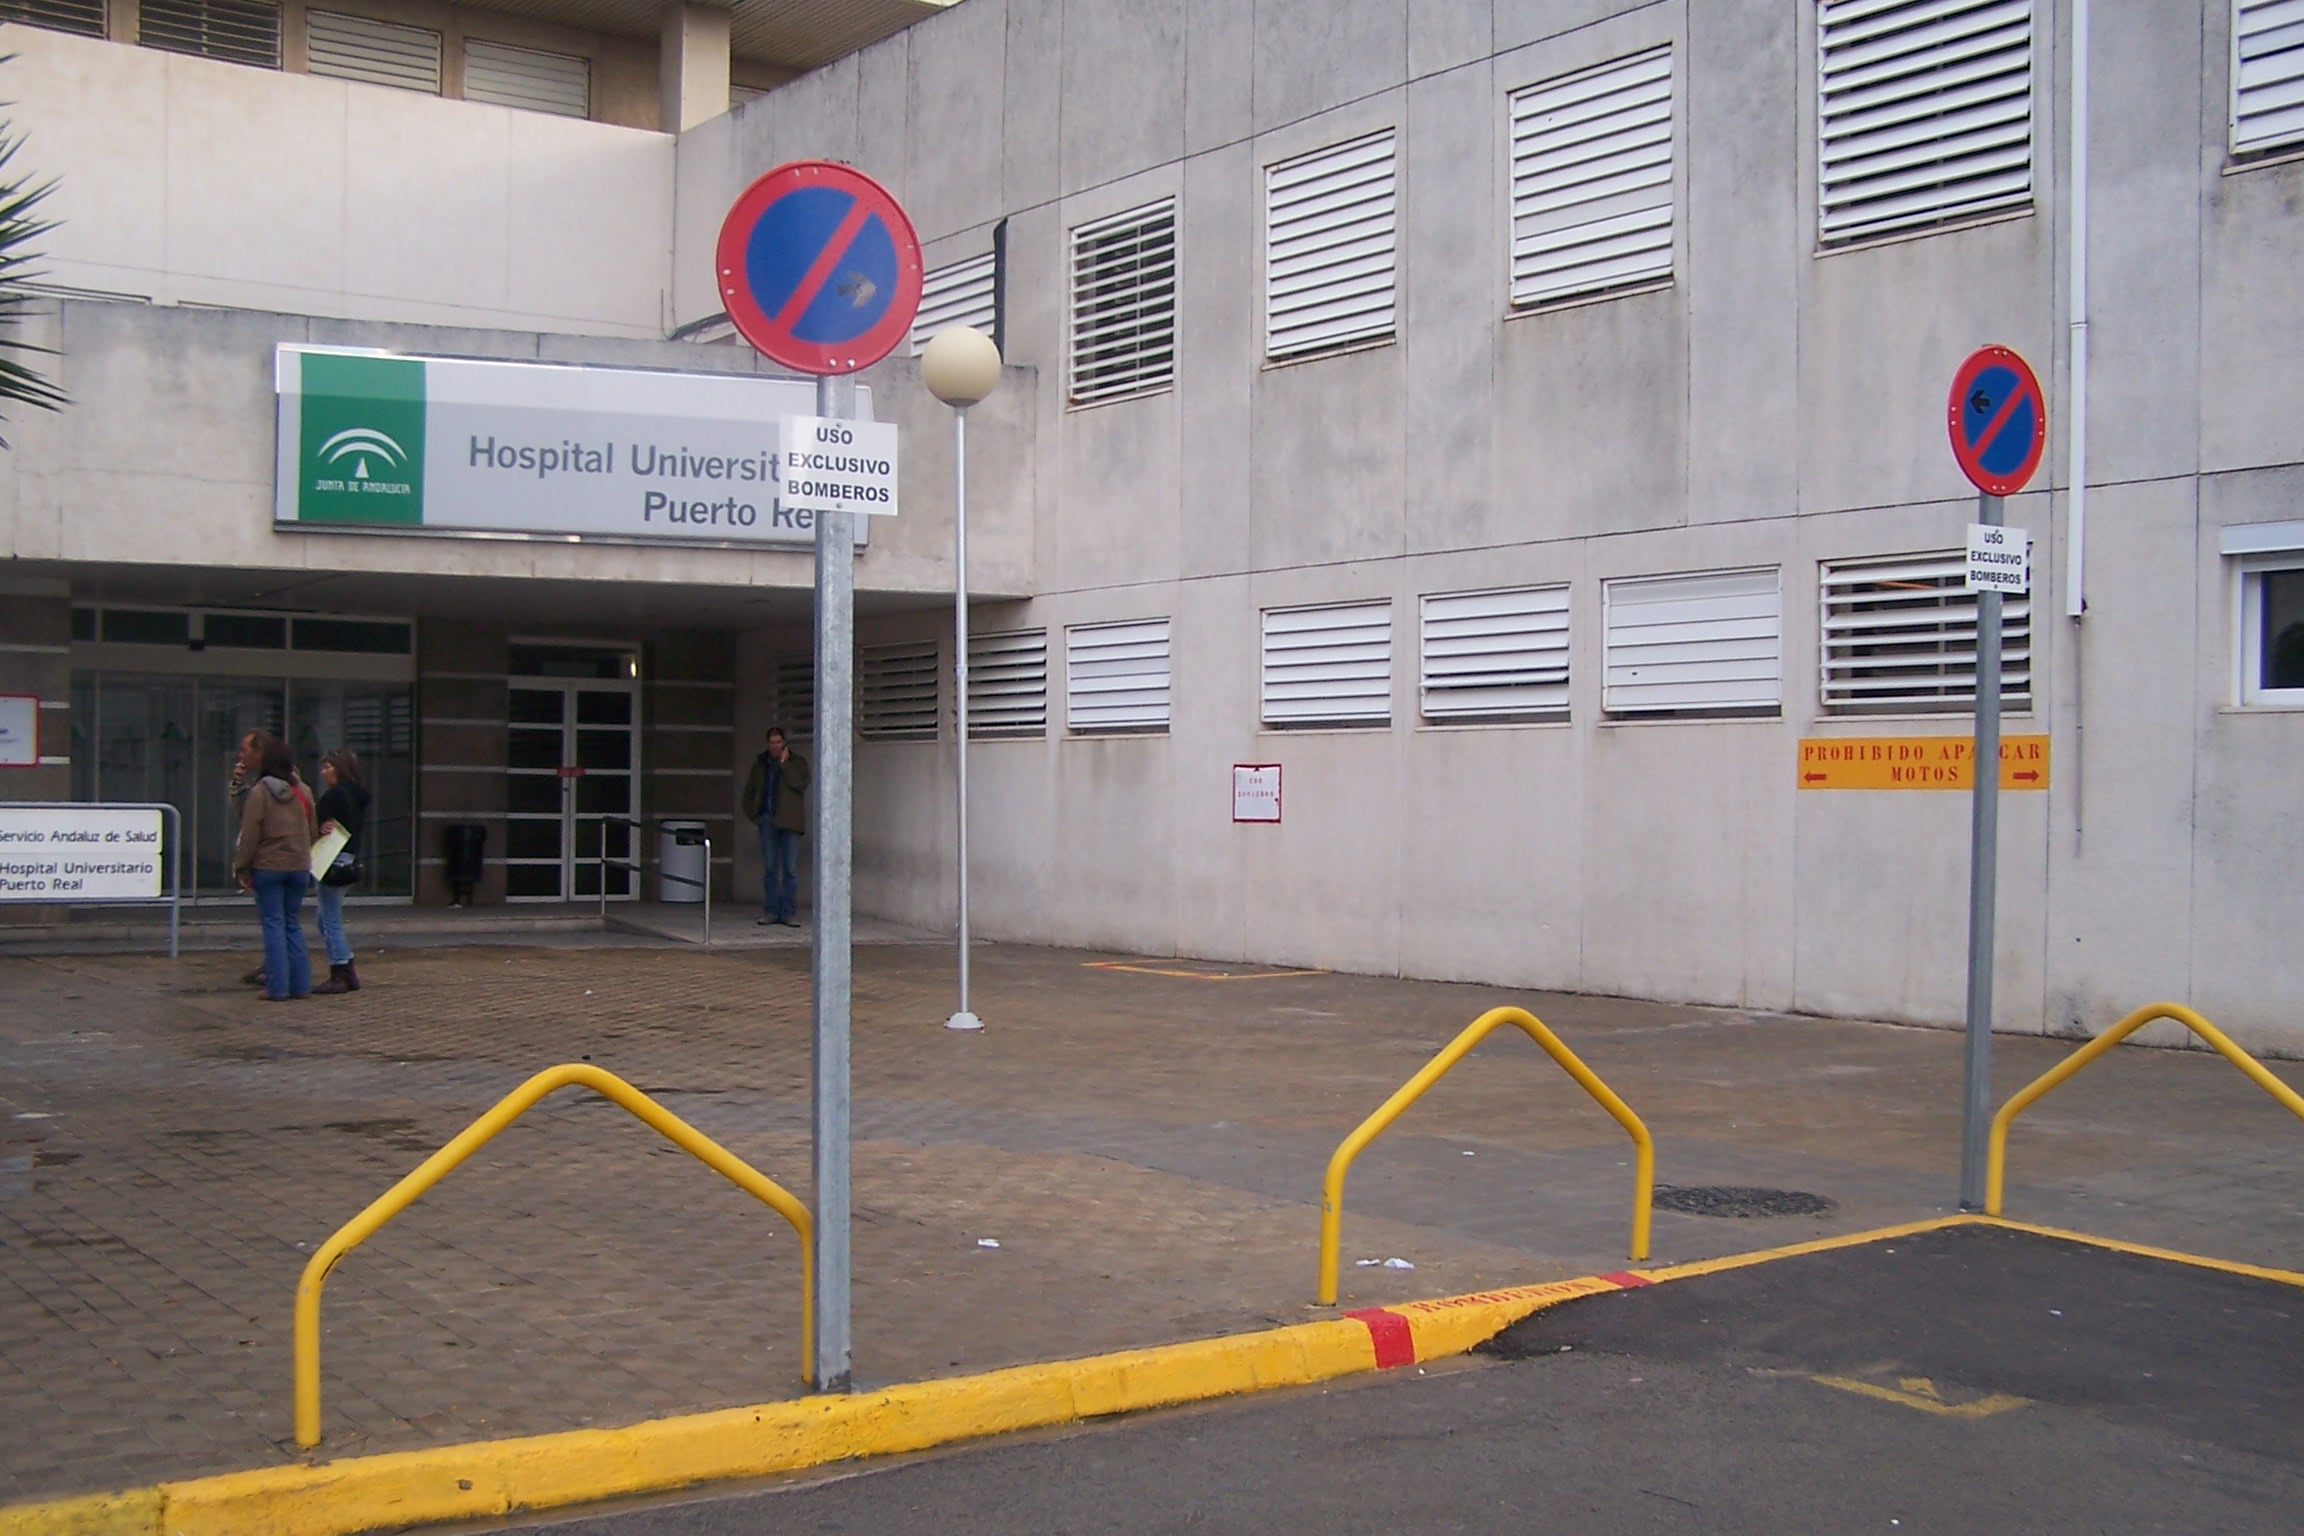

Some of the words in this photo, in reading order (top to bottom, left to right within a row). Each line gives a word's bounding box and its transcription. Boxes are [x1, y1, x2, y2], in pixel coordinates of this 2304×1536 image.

[816, 426, 853, 445] USO
[470, 434, 614, 480] Hospital
[631, 443, 780, 483] Universit
[788, 451, 891, 476] EXCLUSIVO
[787, 479, 890, 503] BOMBEROS
[644, 491, 757, 527] Puerto
[772, 498, 814, 529] Re
[1984, 532, 2004, 545] USO
[1970, 550, 2022, 566] EXCLUSIVO
[1970, 570, 2021, 585] BOMBEROS
[1804, 745, 1924, 762] PROHIBIDO
[1939, 743, 2040, 761] APCAR
[1891, 766, 1959, 782] MOTOS
[51, 830, 100, 843] Andaluz
[105, 830, 120, 843] de
[125, 830, 157, 843] Salud
[0, 861, 57, 877] Hospital
[64, 862, 153, 875] Universitario
[0, 878, 46, 891] Puerto
[52, 878, 83, 891] Real
